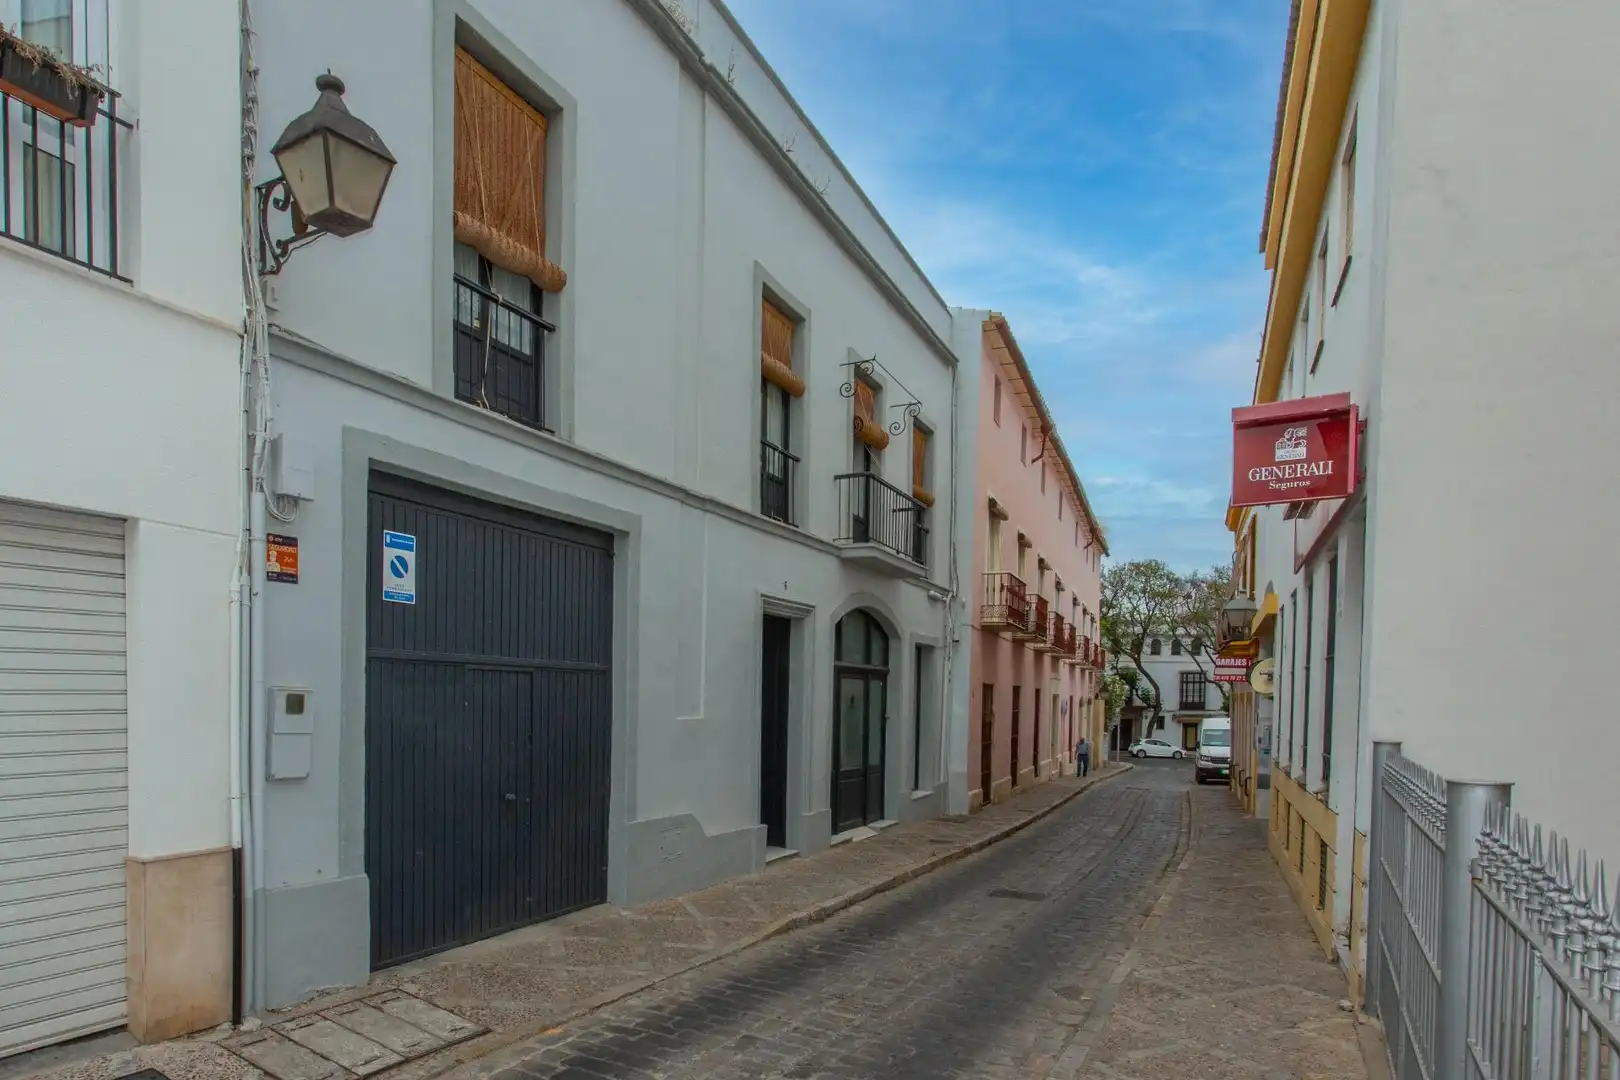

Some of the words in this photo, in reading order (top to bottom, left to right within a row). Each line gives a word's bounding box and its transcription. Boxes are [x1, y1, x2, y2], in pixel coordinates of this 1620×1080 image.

[1248, 460, 1334, 481] GENERALI
[1269, 480, 1310, 490] Seguros
[1215, 658, 1247, 666] GARAJES
